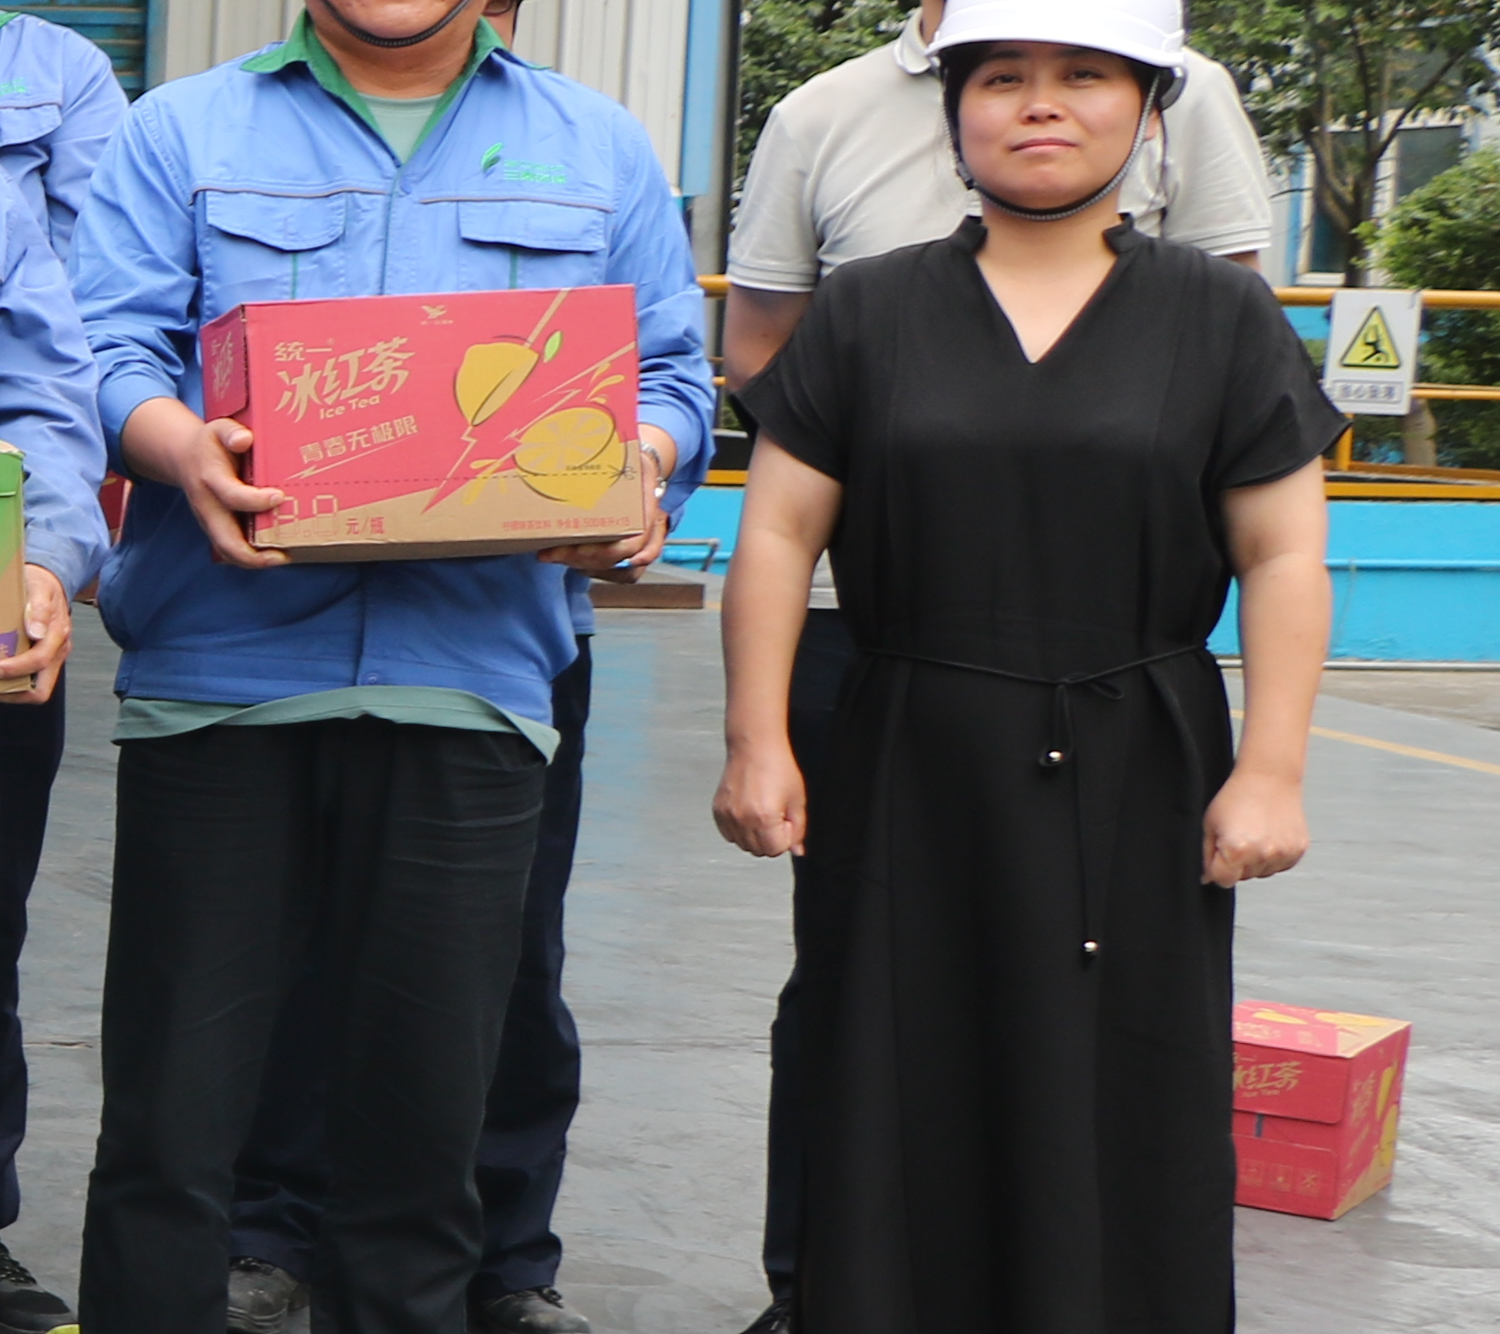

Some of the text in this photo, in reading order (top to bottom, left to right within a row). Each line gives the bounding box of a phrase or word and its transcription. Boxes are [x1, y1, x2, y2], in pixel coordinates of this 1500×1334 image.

[275, 341, 333, 362] 统一
[274, 336, 415, 423] 冰红茶
[319, 394, 381, 419] Ice Tea
[300, 415, 419, 464] 青春无极限
